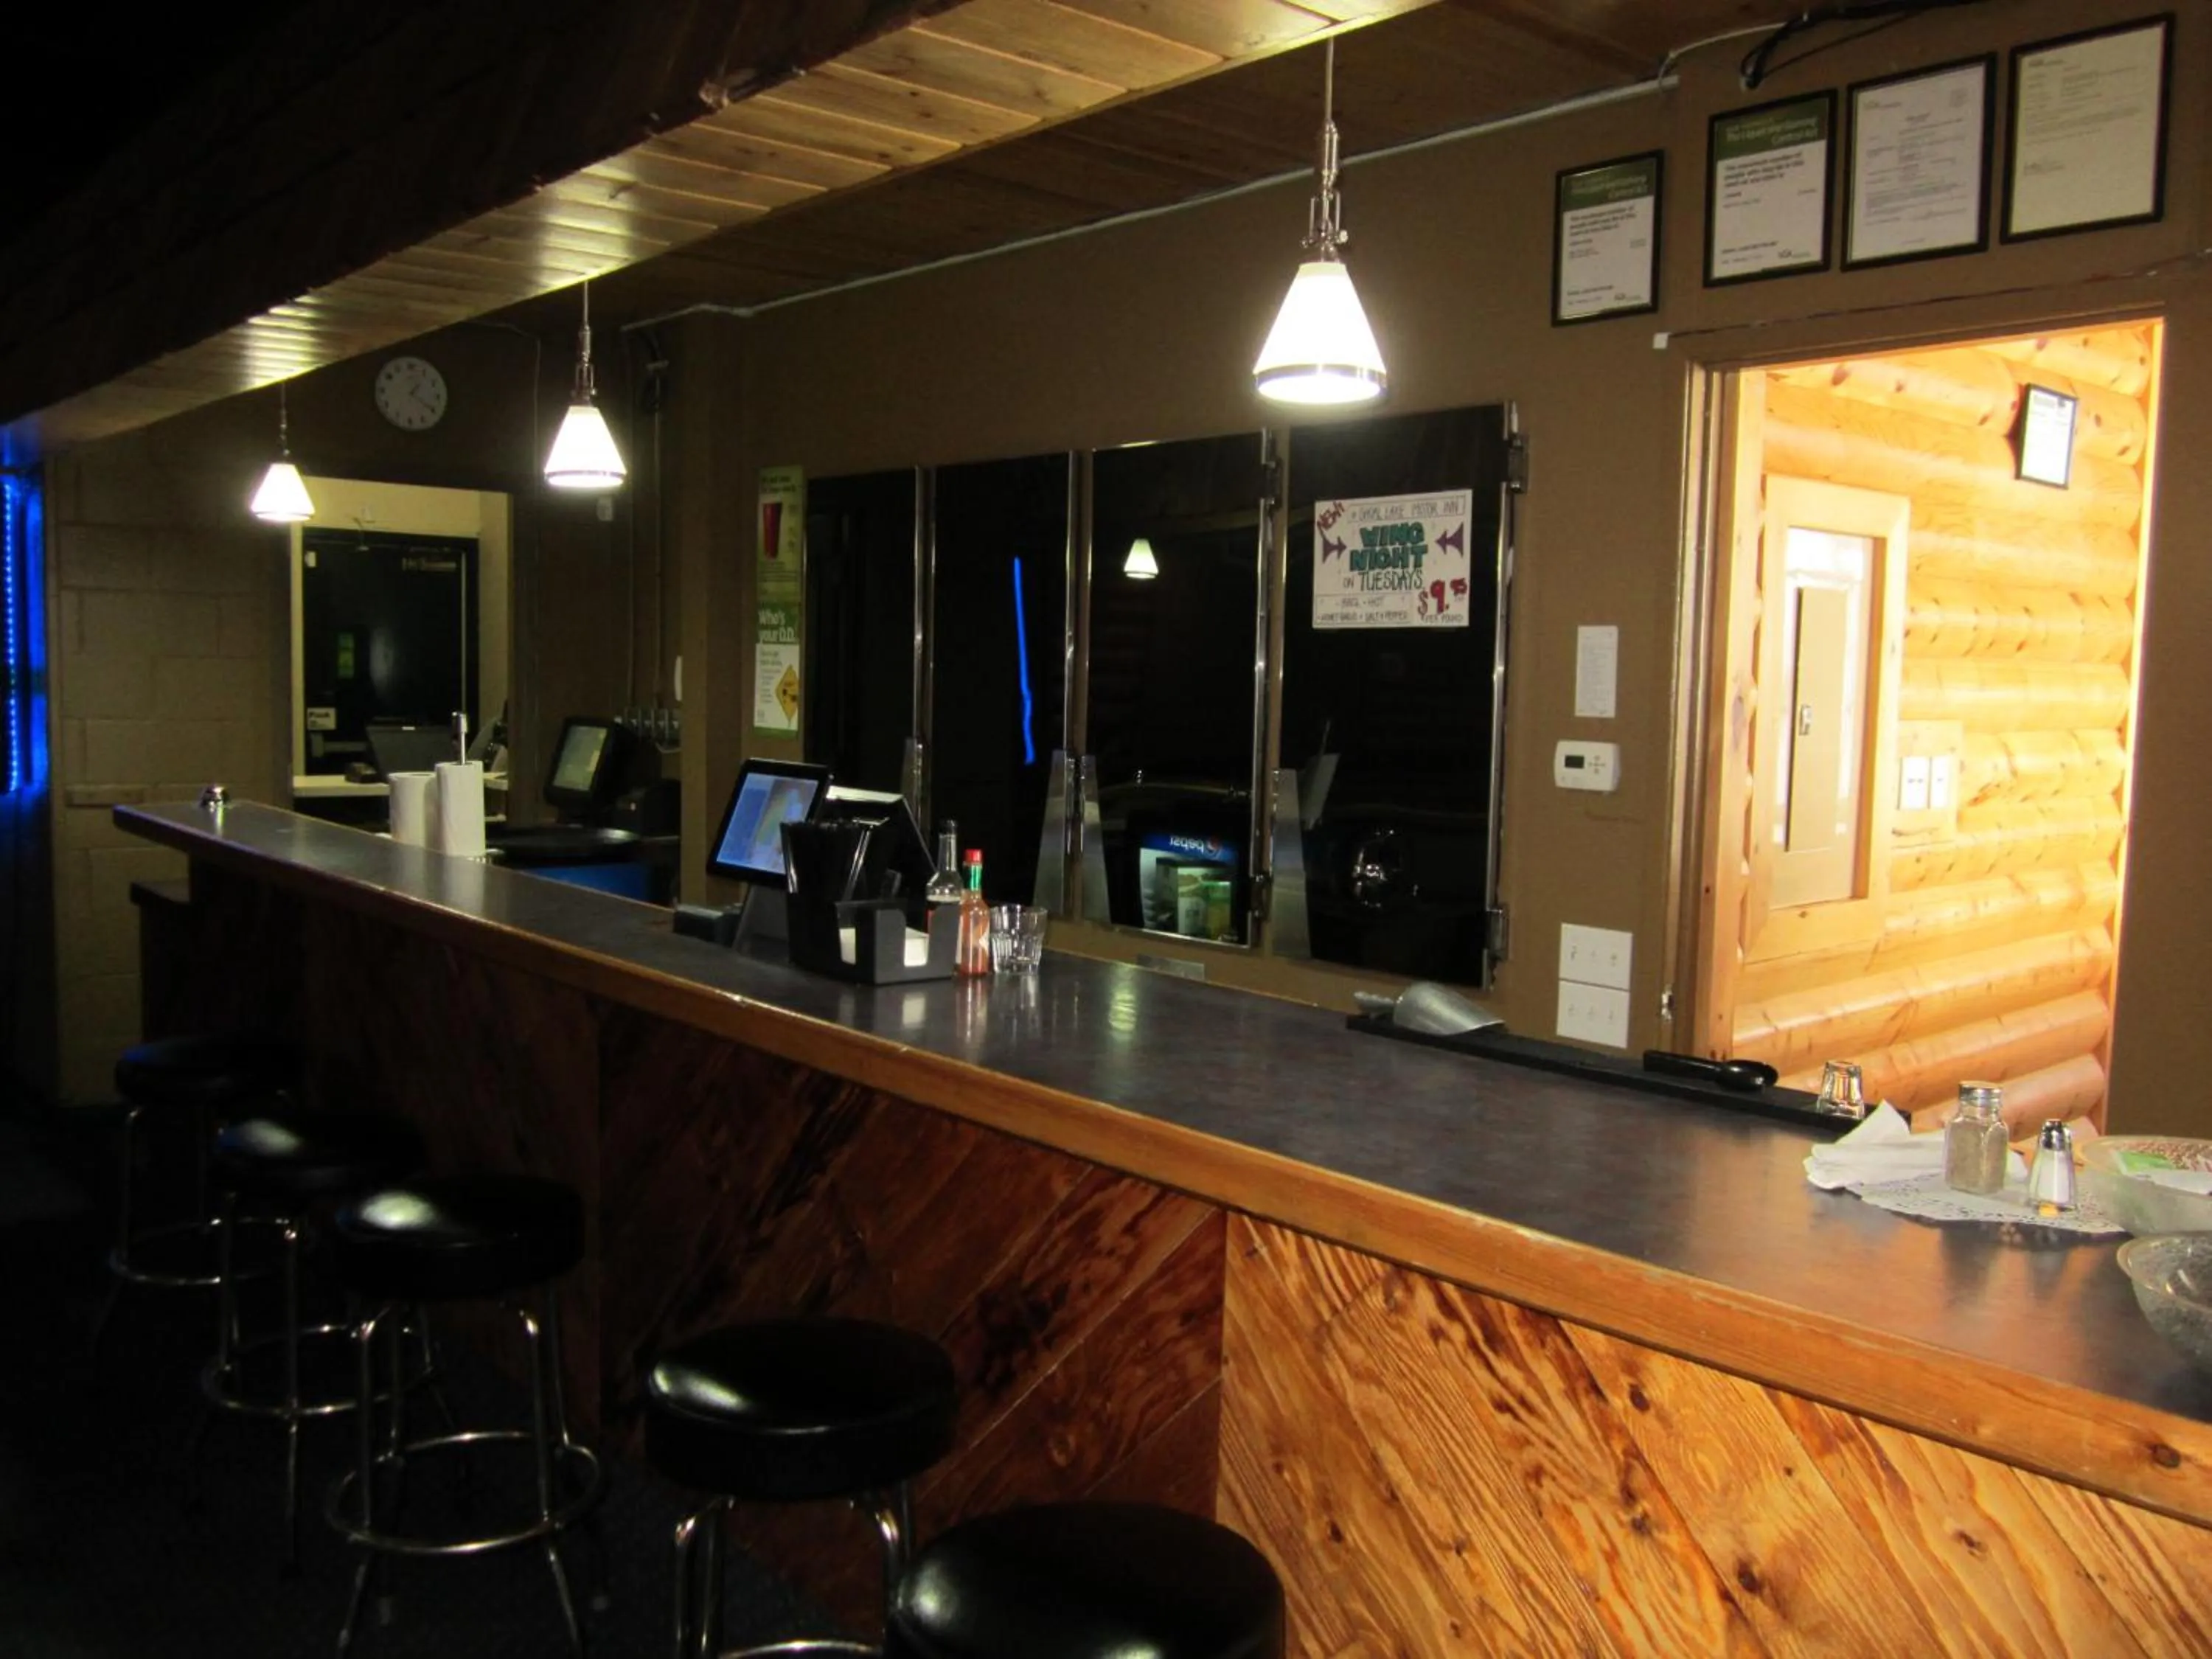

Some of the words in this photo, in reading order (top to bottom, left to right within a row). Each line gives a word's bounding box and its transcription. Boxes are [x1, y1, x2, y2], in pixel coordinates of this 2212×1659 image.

[1360, 522, 1425, 546] WING
[1349, 544, 1428, 571] NIGHT
[1357, 568, 1422, 591] TUESDAYS
